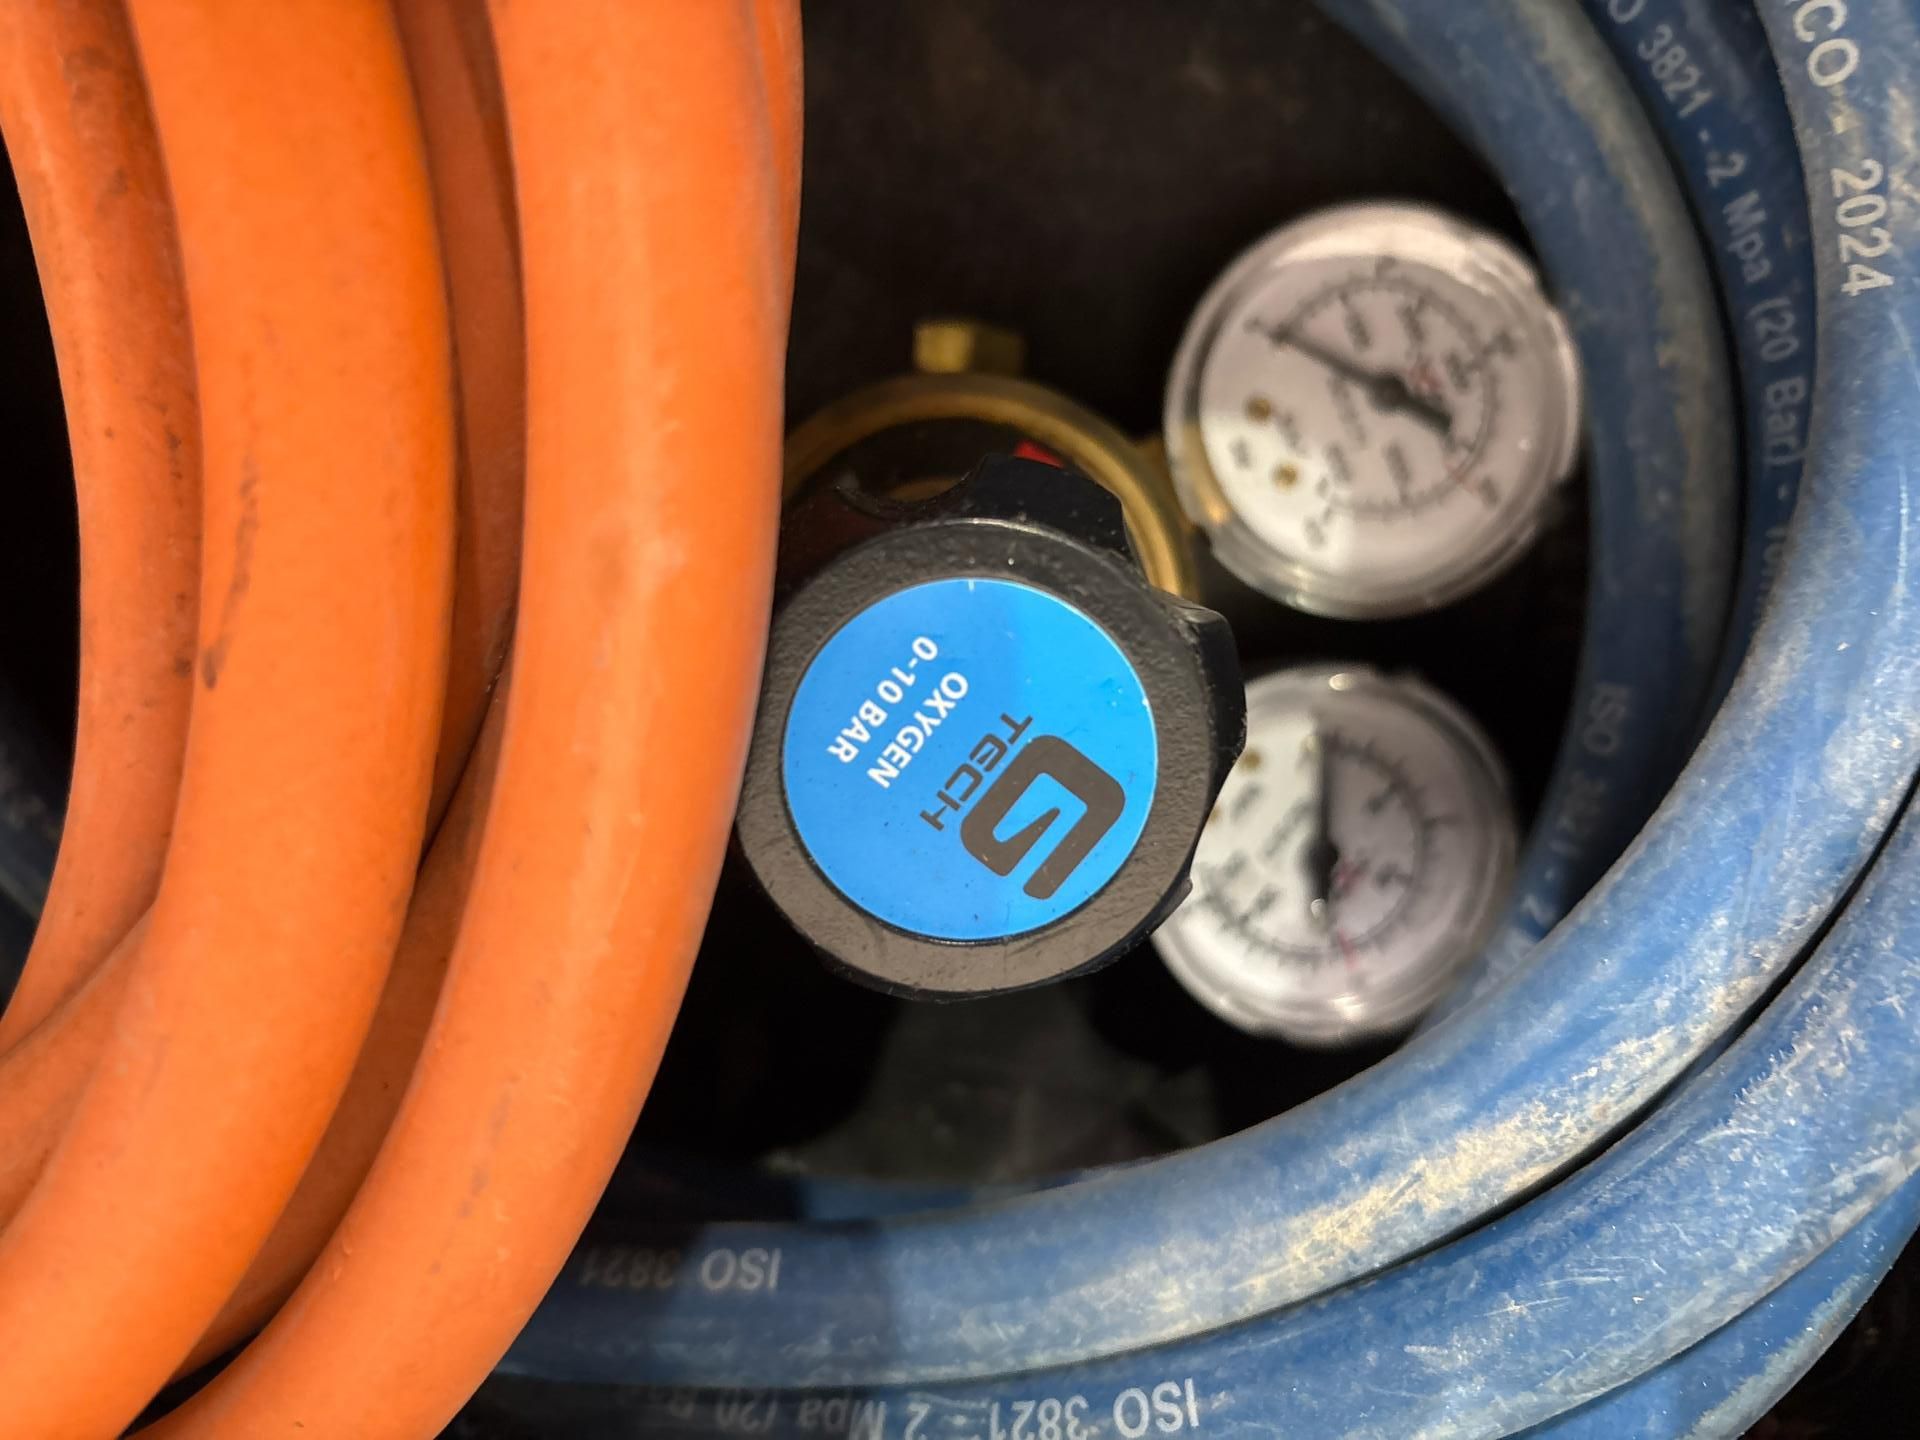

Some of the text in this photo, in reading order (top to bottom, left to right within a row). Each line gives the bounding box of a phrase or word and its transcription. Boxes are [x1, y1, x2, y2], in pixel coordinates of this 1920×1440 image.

[1638, 24, 1712, 119] 3821
[1706, 152, 1747, 189] 2
[1786, 0, 1859, 87] CO
[1831, 159, 1894, 297] 2024
[1723, 190, 1772, 284] Mpa
[1746, 298, 1800, 362] (20
[827, 637, 938, 763] 0-10 BAR
[867, 672, 968, 788] OXYGEN
[920, 713, 1033, 831] TECH
[960, 735, 1126, 900] G
[580, 1247, 782, 1291] ISO 3821
[797, 1393, 888, 1440] Mpa
[904, 1398, 932, 1440] 2
[988, 1396, 1089, 1440] 3821
[1112, 1377, 1199, 1438] ISO
